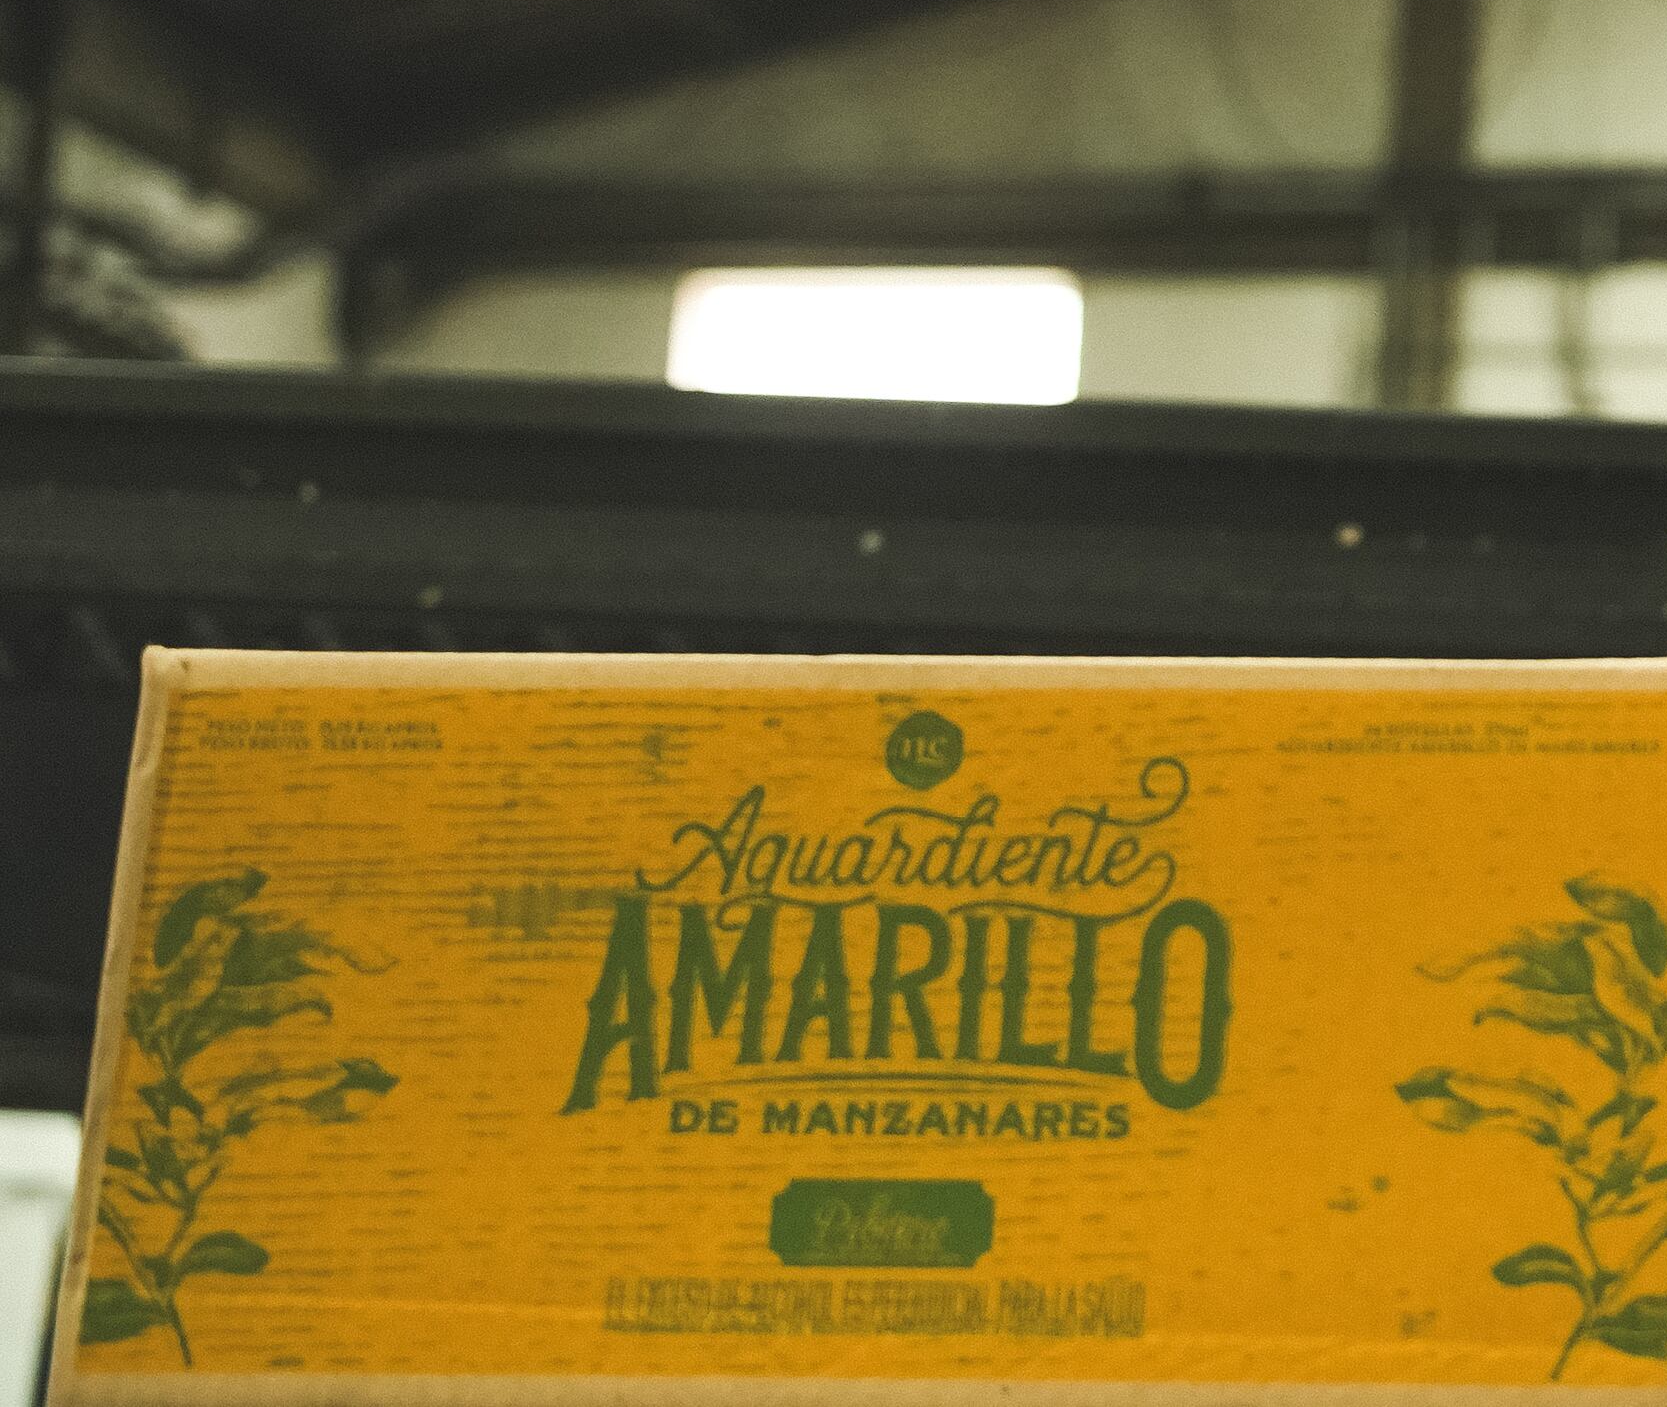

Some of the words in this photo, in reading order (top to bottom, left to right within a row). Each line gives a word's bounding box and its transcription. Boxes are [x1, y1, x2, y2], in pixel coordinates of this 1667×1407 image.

[634, 754, 1189, 931] Aguardiente
[558, 895, 1233, 1116] AMARILLO
[669, 1098, 739, 1136] DE
[760, 1098, 1132, 1141] MANZANARES
